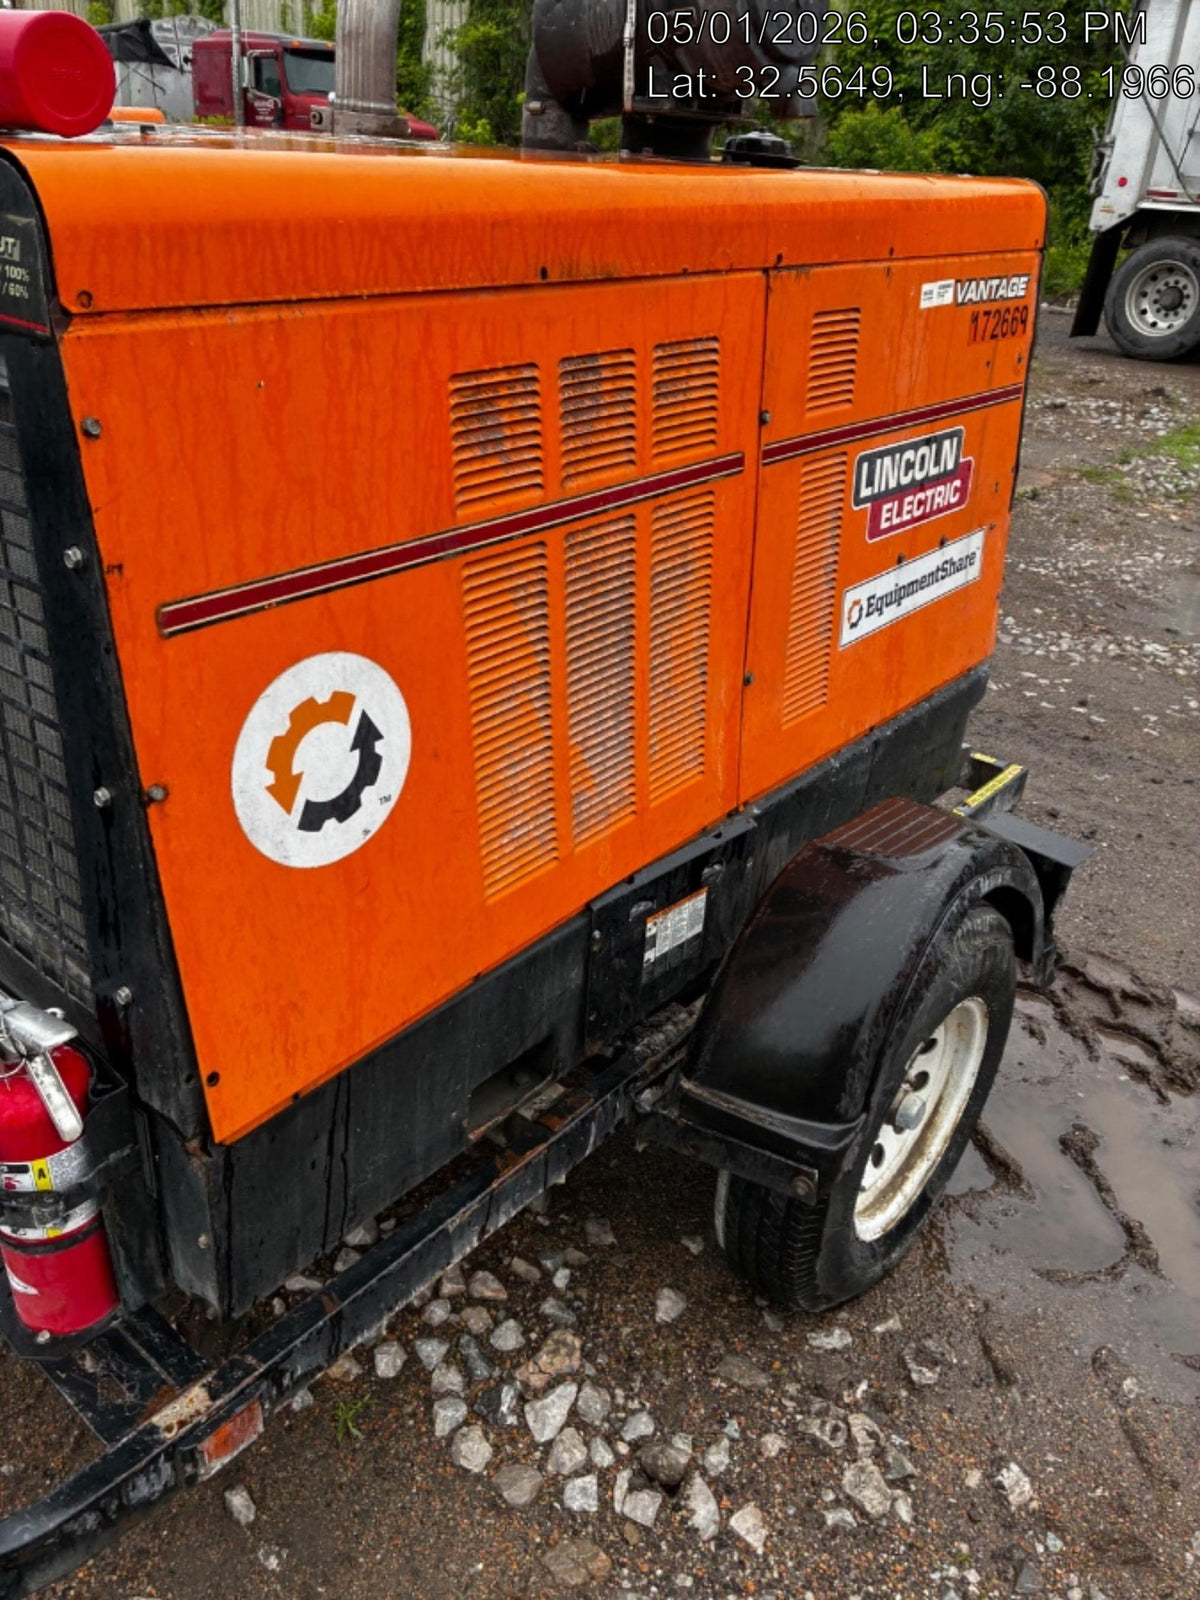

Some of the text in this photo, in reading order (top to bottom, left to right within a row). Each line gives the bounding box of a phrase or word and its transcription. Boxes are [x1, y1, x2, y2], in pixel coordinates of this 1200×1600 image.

[956, 274, 1031, 305] VANTAGE
[970, 305, 1029, 342] 172669
[859, 437, 959, 499] LINCOLN
[879, 478, 962, 530] ELECTRIC
[864, 550, 977, 618] EquipmentShare
